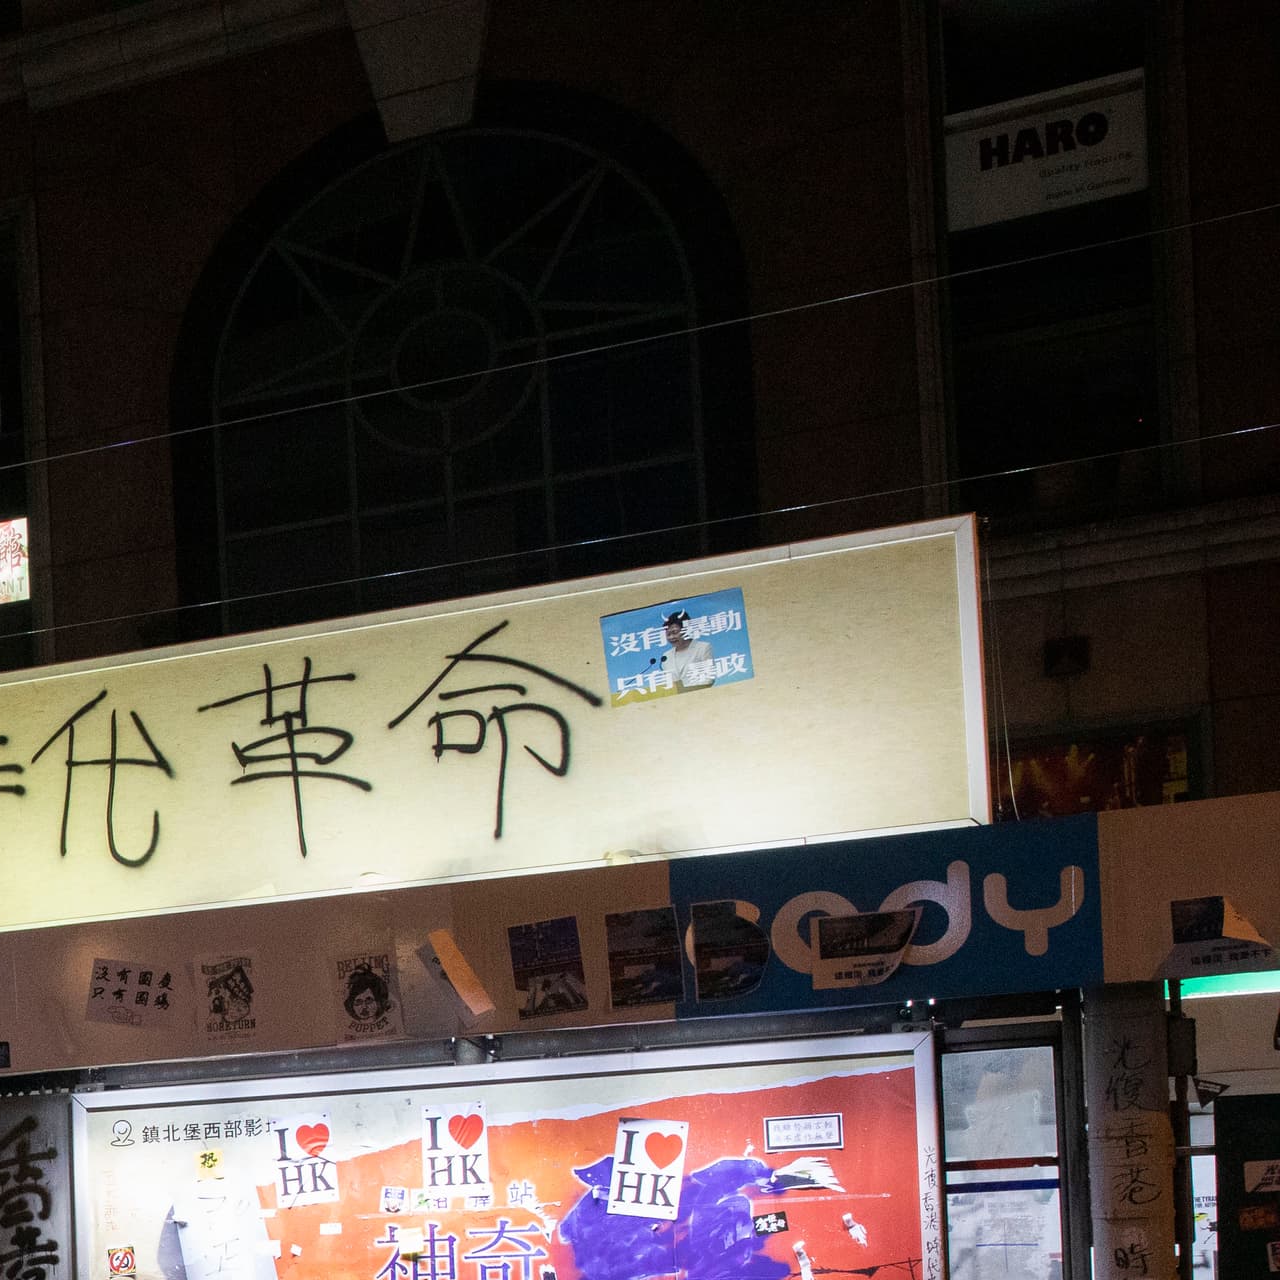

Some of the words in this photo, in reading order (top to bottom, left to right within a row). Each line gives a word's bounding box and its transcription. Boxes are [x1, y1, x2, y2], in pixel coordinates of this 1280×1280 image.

[980, 112, 1108, 171] HARO
[348, 1016, 390, 1034] PUPPET
[274, 1127, 290, 1162] I
[426, 1116, 443, 1151] I
[618, 1129, 640, 1167] I
[279, 1161, 335, 1197] HK
[427, 1153, 487, 1188] HK
[613, 1169, 676, 1208] HK
